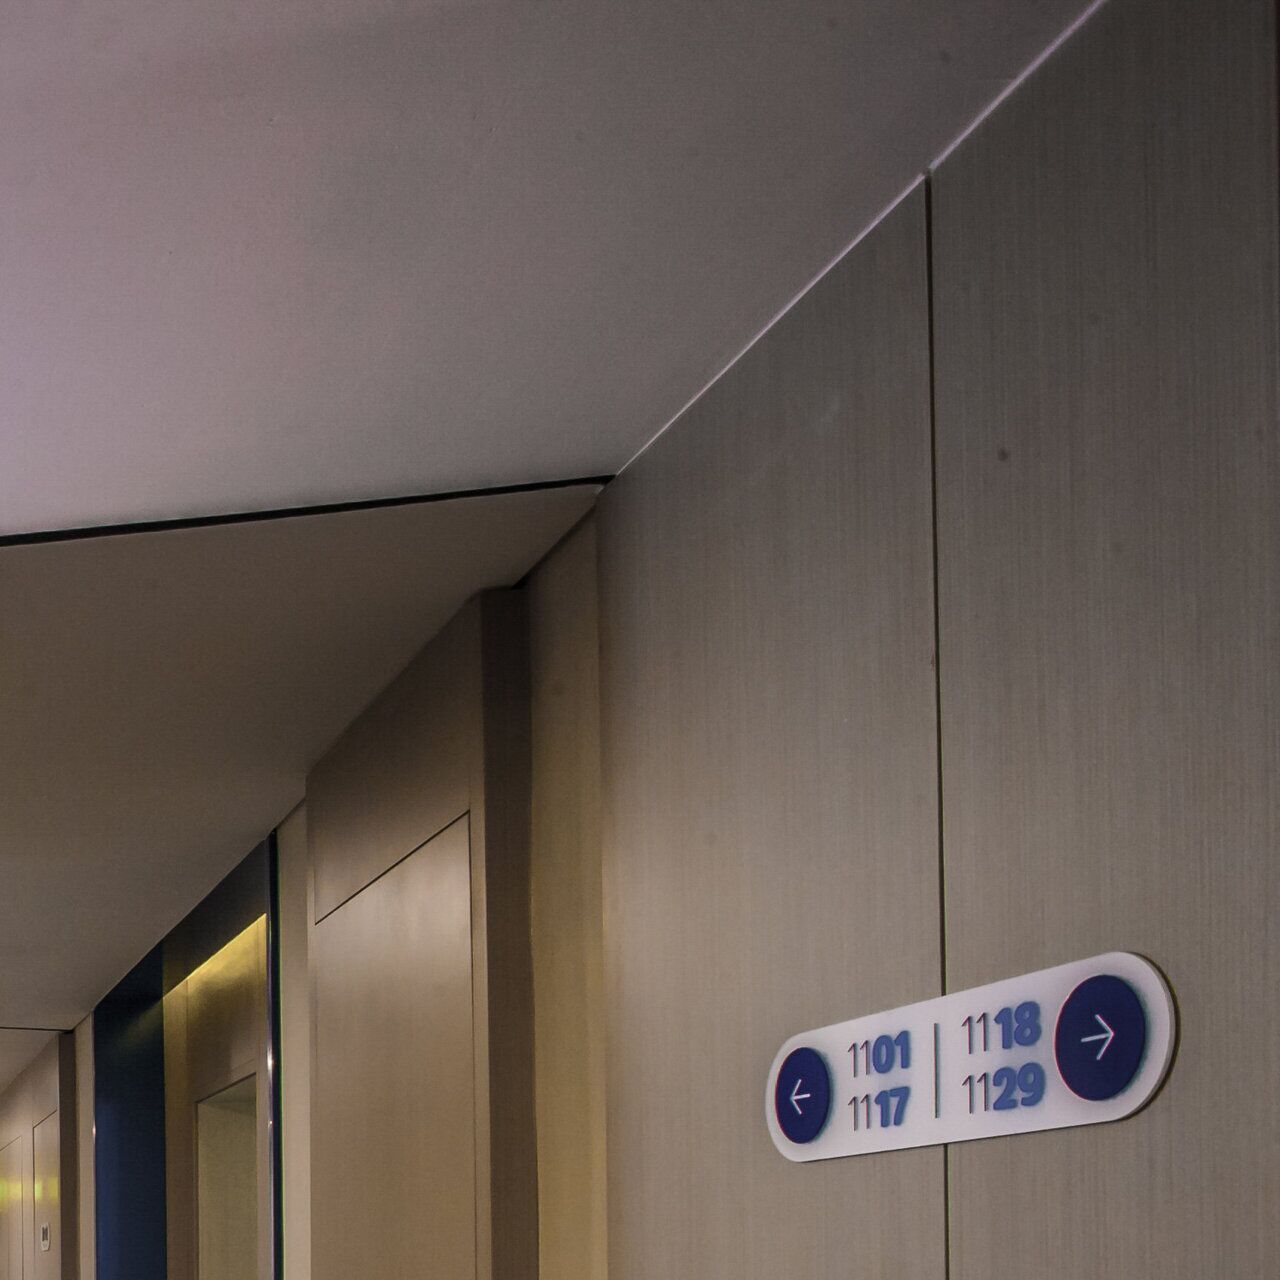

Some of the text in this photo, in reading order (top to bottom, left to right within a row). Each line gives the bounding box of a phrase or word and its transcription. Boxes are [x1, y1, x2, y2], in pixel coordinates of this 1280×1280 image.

[961, 1001, 1040, 1055] 1118
[848, 1030, 910, 1078] 1101
[848, 1086, 910, 1131] 1117
[962, 1062, 1045, 1114] 1129
